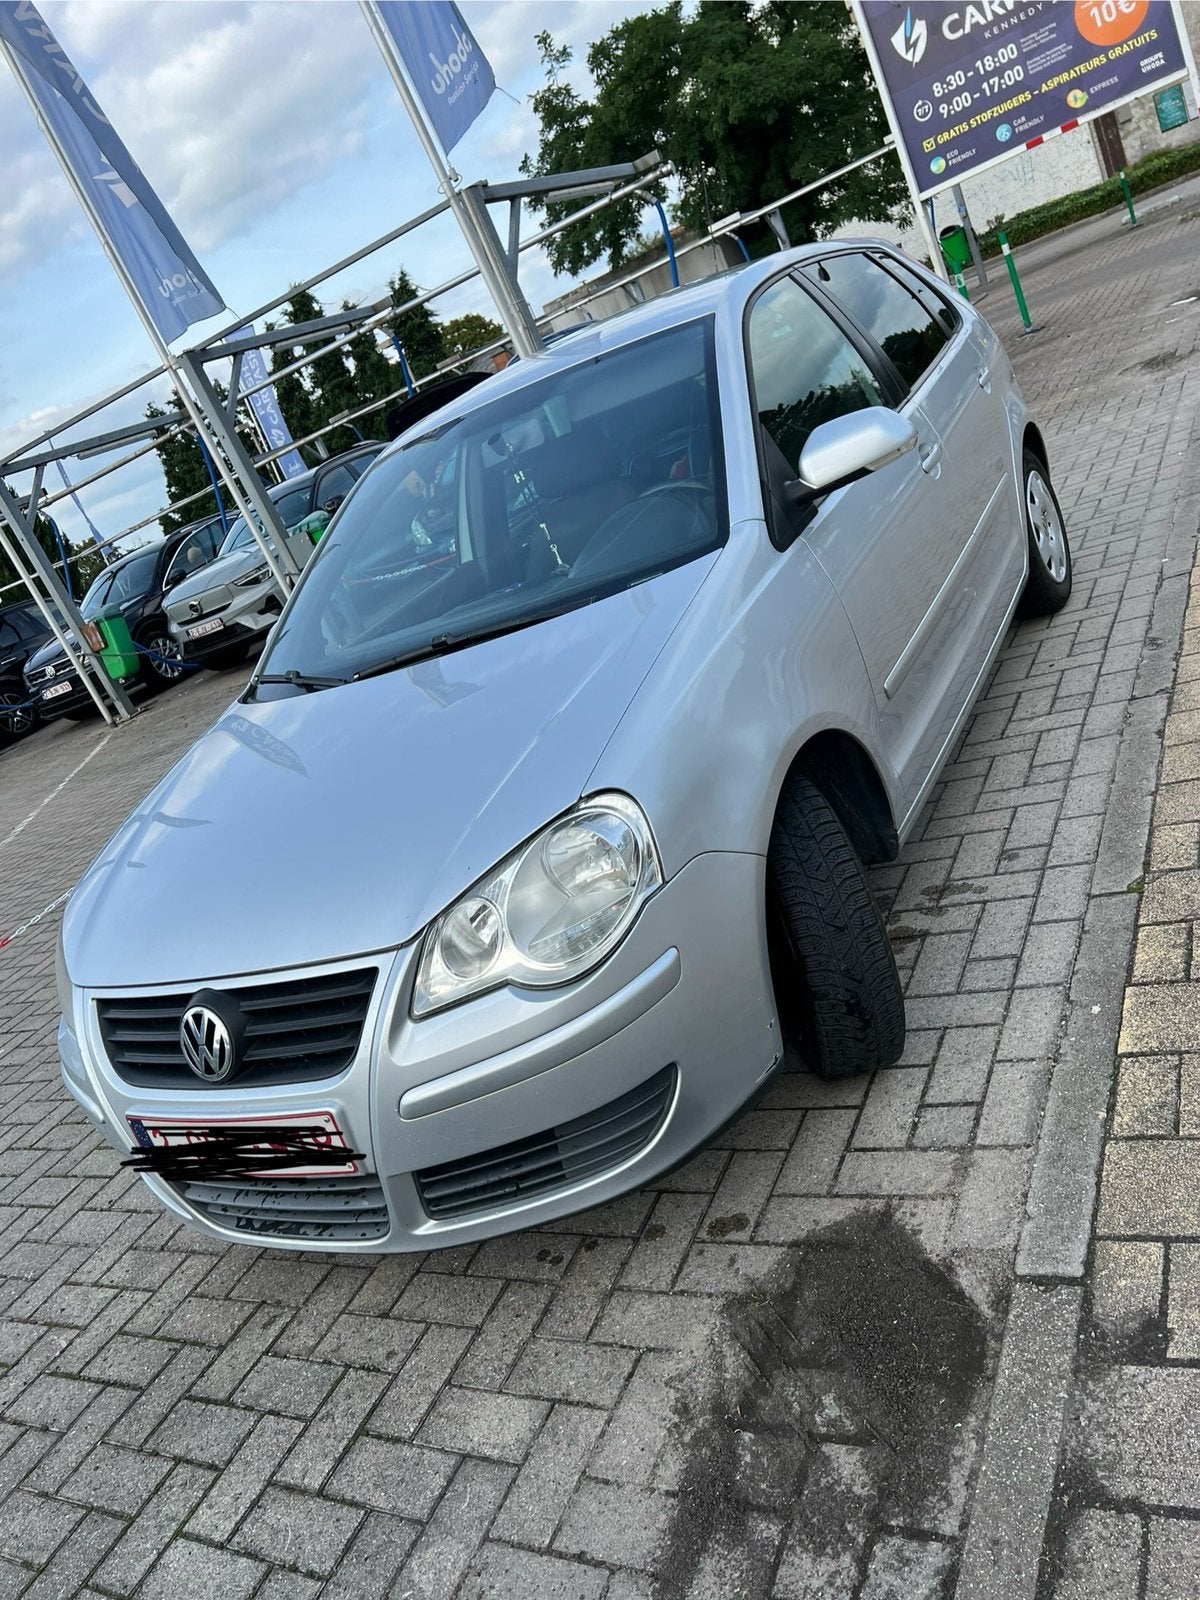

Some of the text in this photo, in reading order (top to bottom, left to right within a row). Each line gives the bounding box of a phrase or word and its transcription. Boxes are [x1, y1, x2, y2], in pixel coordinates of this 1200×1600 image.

[984, 3, 1043, 39] KENNEDY
[1090, 0, 1136, 28] 10€
[932, 70, 966, 97] 8:30
[975, 43, 1018, 75] 18:00
[937, 122, 969, 144] GRATIS
[969, 90, 1032, 128] STOFZUIGERS
[1041, 54, 1107, 93] ASPIRATEURS
[1108, 29, 1158, 60] GRATUITS
[939, 91, 972, 119] 9:00
[982, 65, 1025, 97] 17:00
[1089, 75, 1119, 94] EXPRESS
[1013, 116, 1026, 126] CAR
[1015, 114, 1045, 134] FRIENDLY
[946, 149, 959, 159] ECO
[948, 148, 976, 166] FRIENDLY
